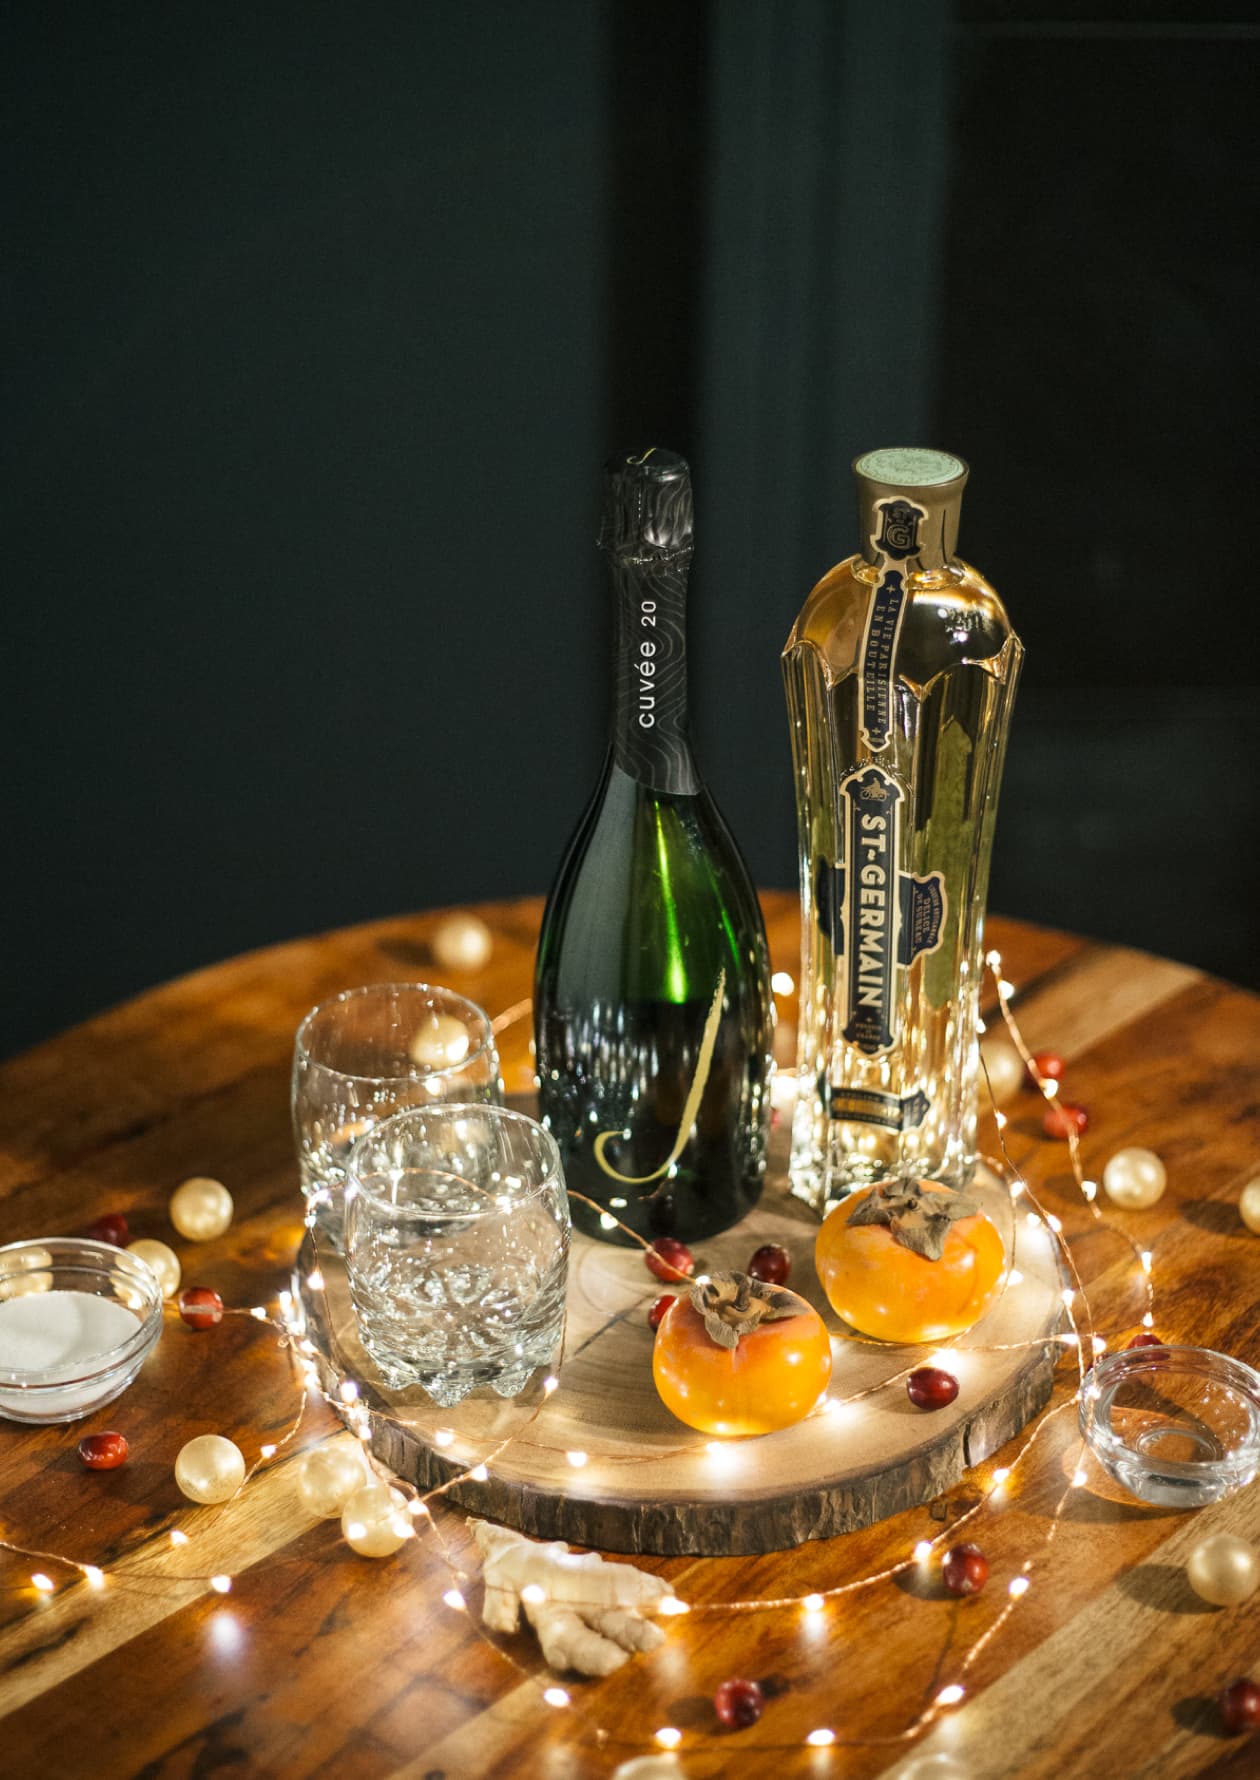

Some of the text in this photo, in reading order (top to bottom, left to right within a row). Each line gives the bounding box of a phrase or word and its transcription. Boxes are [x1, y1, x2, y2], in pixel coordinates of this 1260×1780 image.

[882, 619, 895, 640] VIE
[887, 598, 899, 613] LA
[633, 601, 657, 728] cuvée 20
[866, 605, 886, 712] EN BOUTEILLE
[877, 644, 890, 725] PARISIENNE
